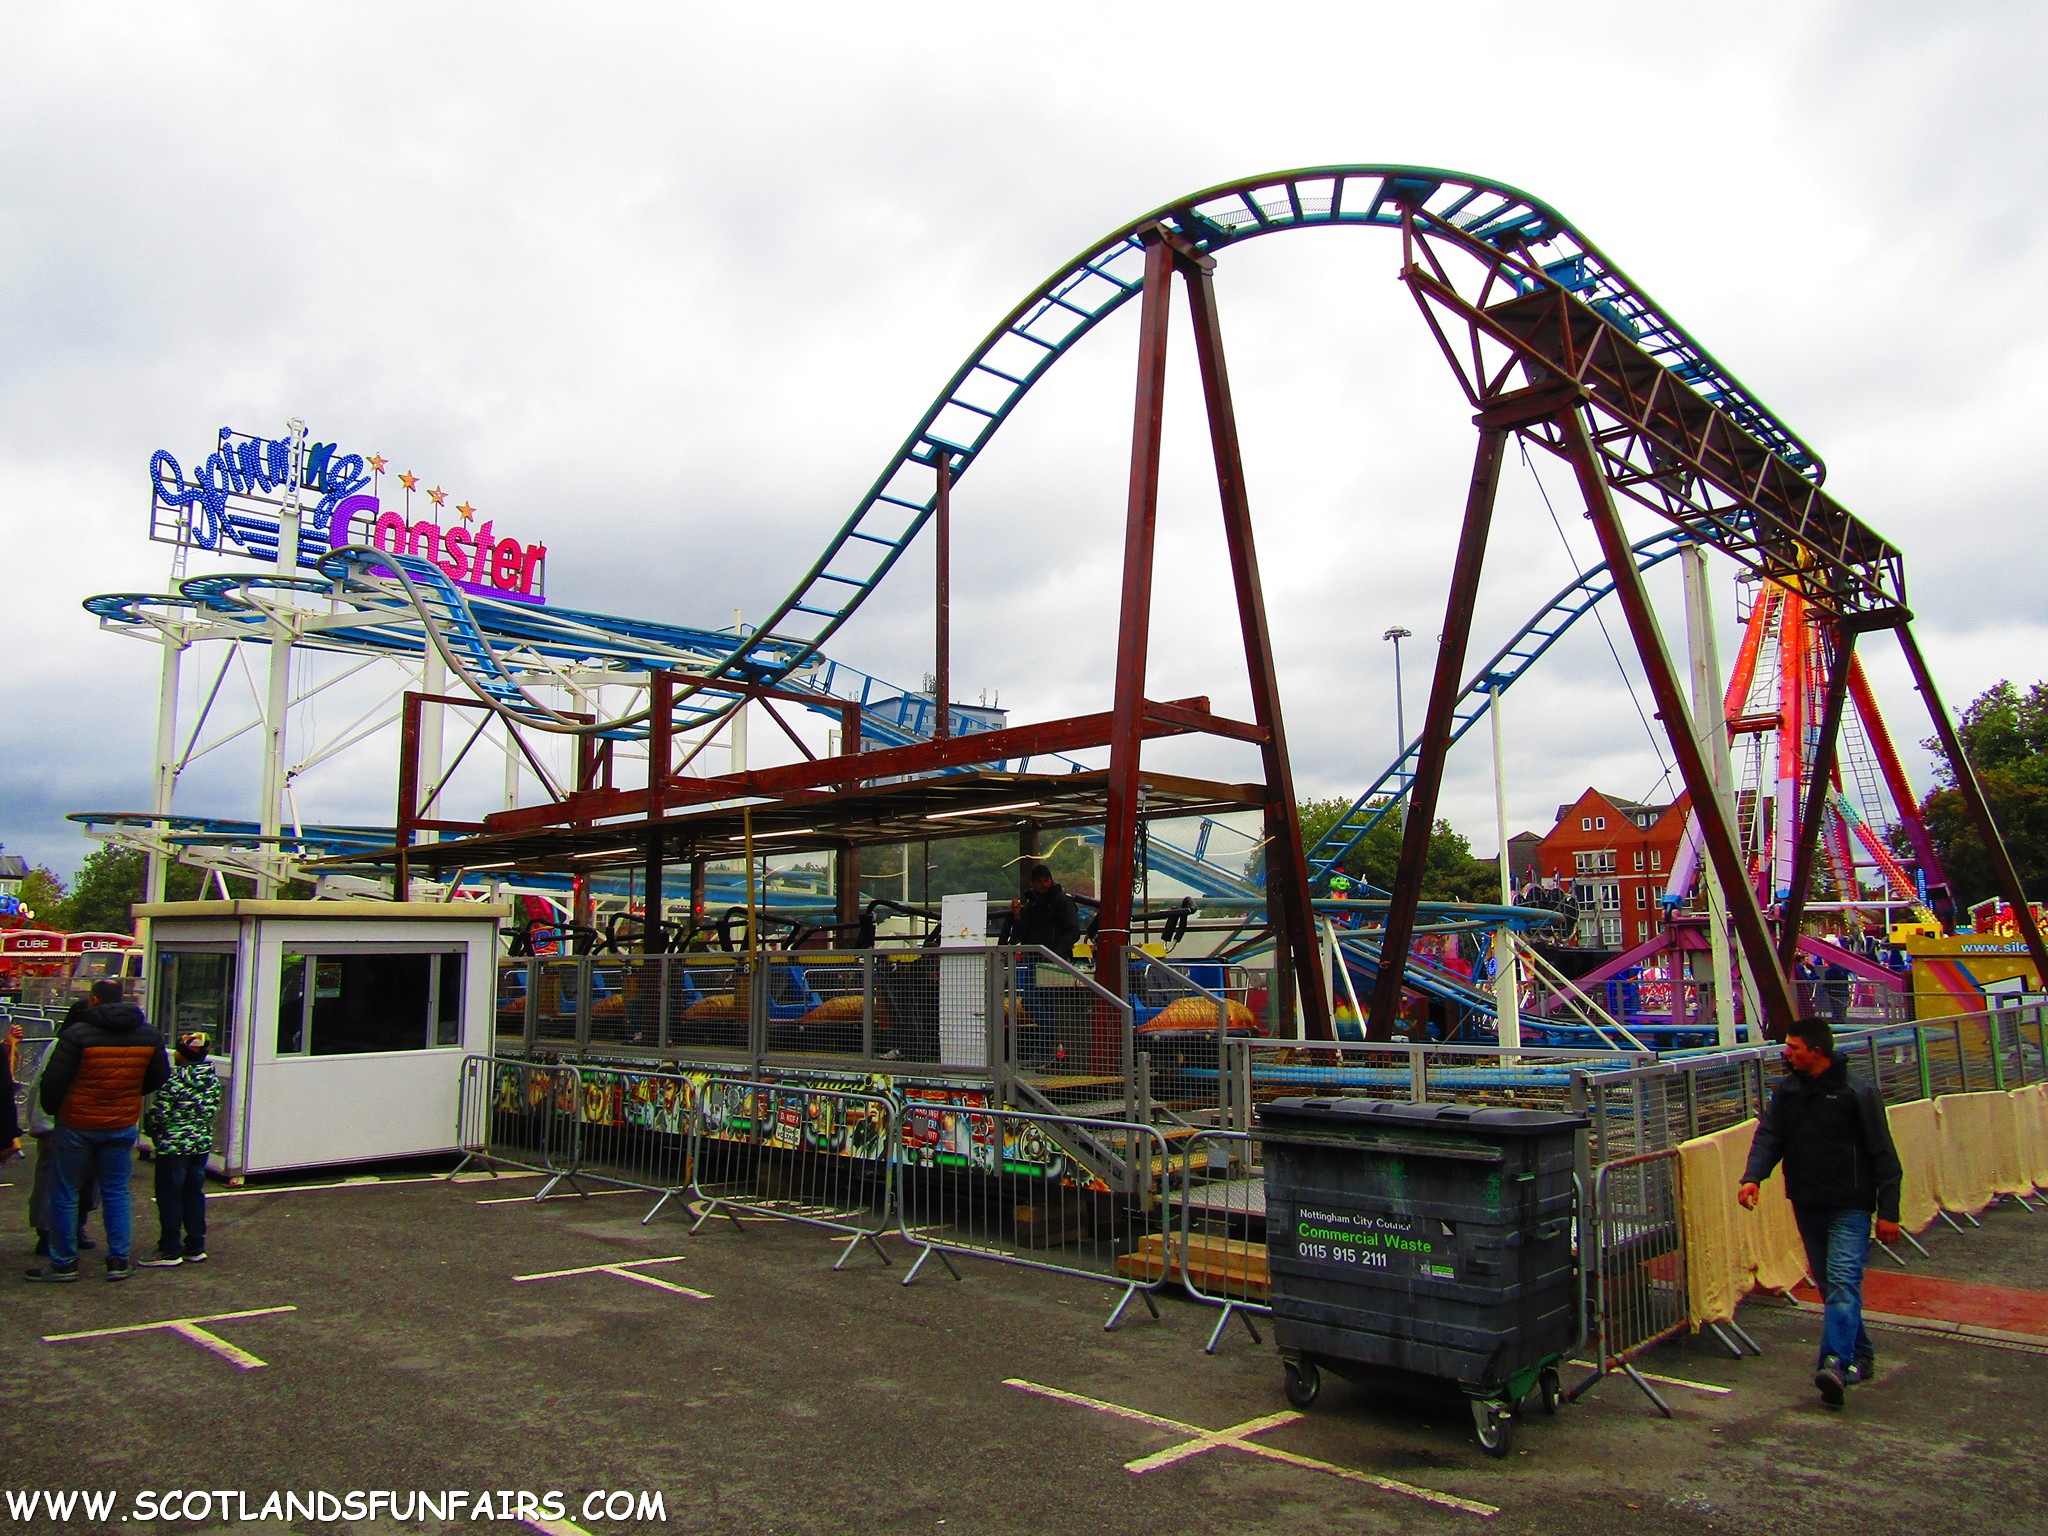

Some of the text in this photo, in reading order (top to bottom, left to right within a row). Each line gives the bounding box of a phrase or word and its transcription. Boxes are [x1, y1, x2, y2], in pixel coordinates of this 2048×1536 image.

[329, 494, 547, 594] Coaster
[16, 939, 49, 949] CUBE
[1961, 941, 2030, 953] www.silc
[1299, 1208, 1350, 1224] Nottingham
[1352, 1214, 1373, 1229] City
[1298, 1223, 1432, 1253] Commercial Waste
[1298, 1242, 1387, 1267] 0115 915 2111
